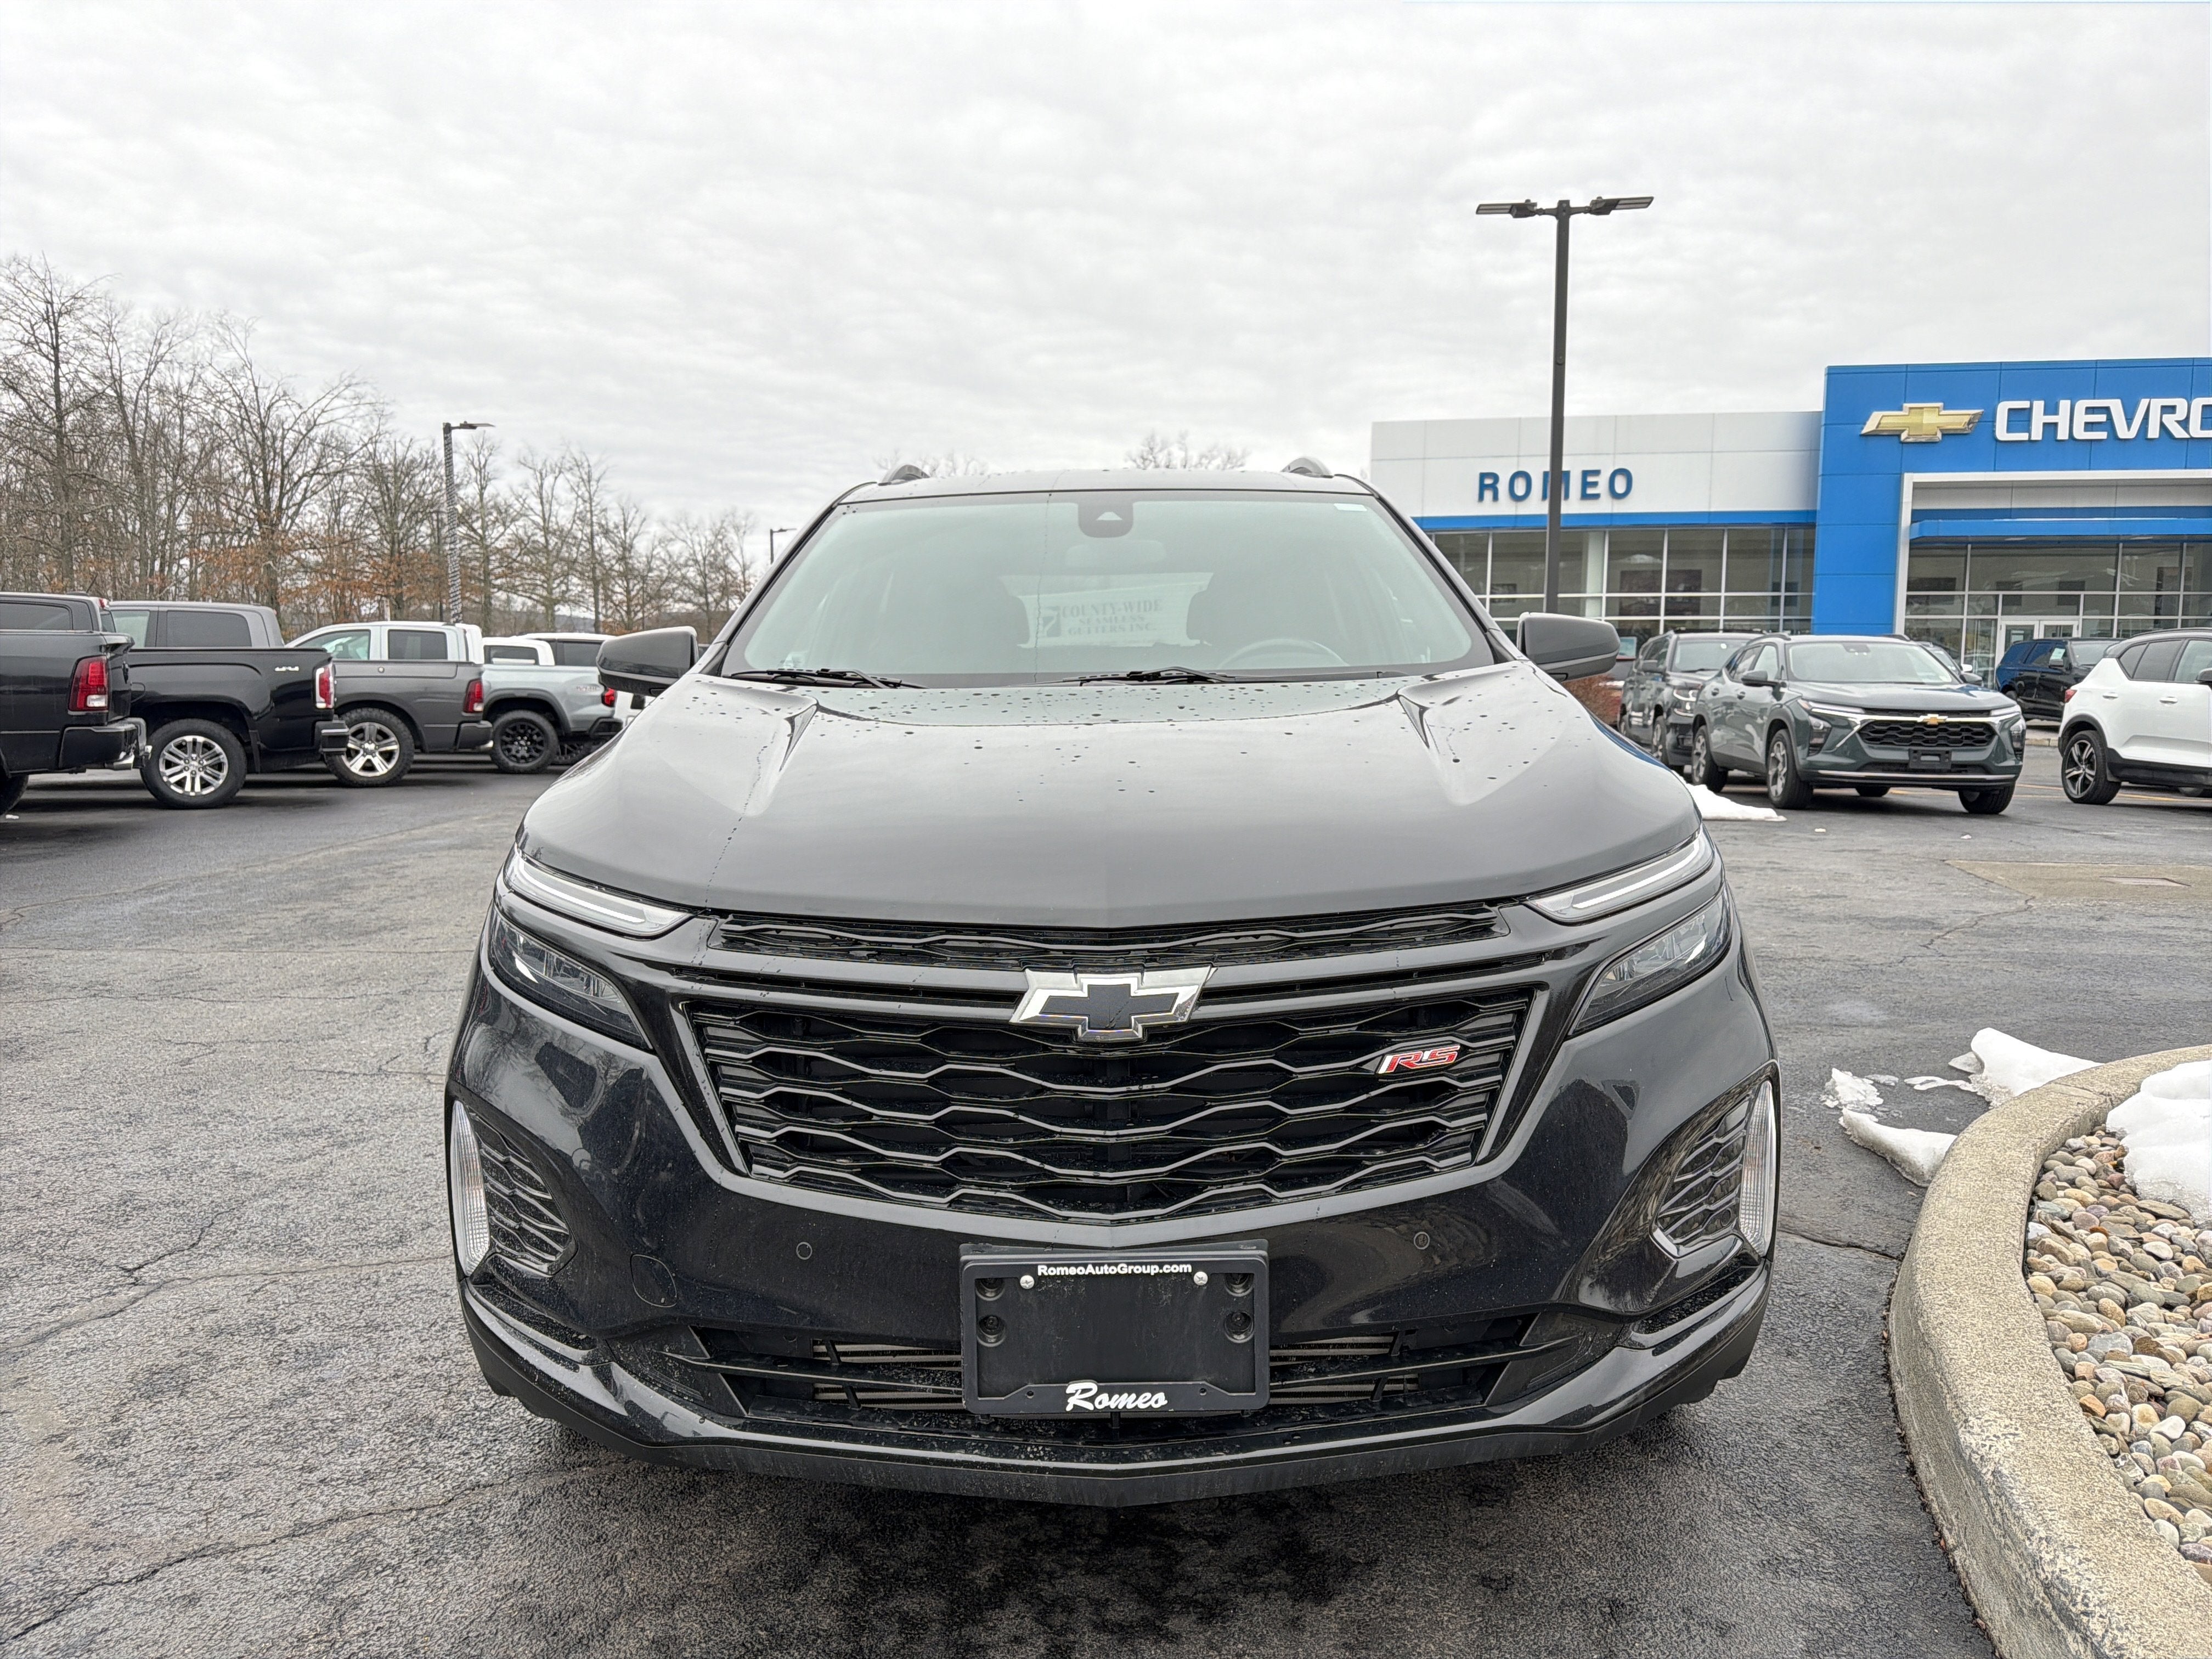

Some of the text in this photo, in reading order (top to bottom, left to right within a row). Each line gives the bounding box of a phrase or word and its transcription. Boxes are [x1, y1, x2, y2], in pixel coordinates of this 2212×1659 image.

[1378, 1045, 1460, 1074] RS
[1037, 1263, 1192, 1276] RomeoAutoGroup.com
[1066, 1382, 1167, 1412] Romeo
